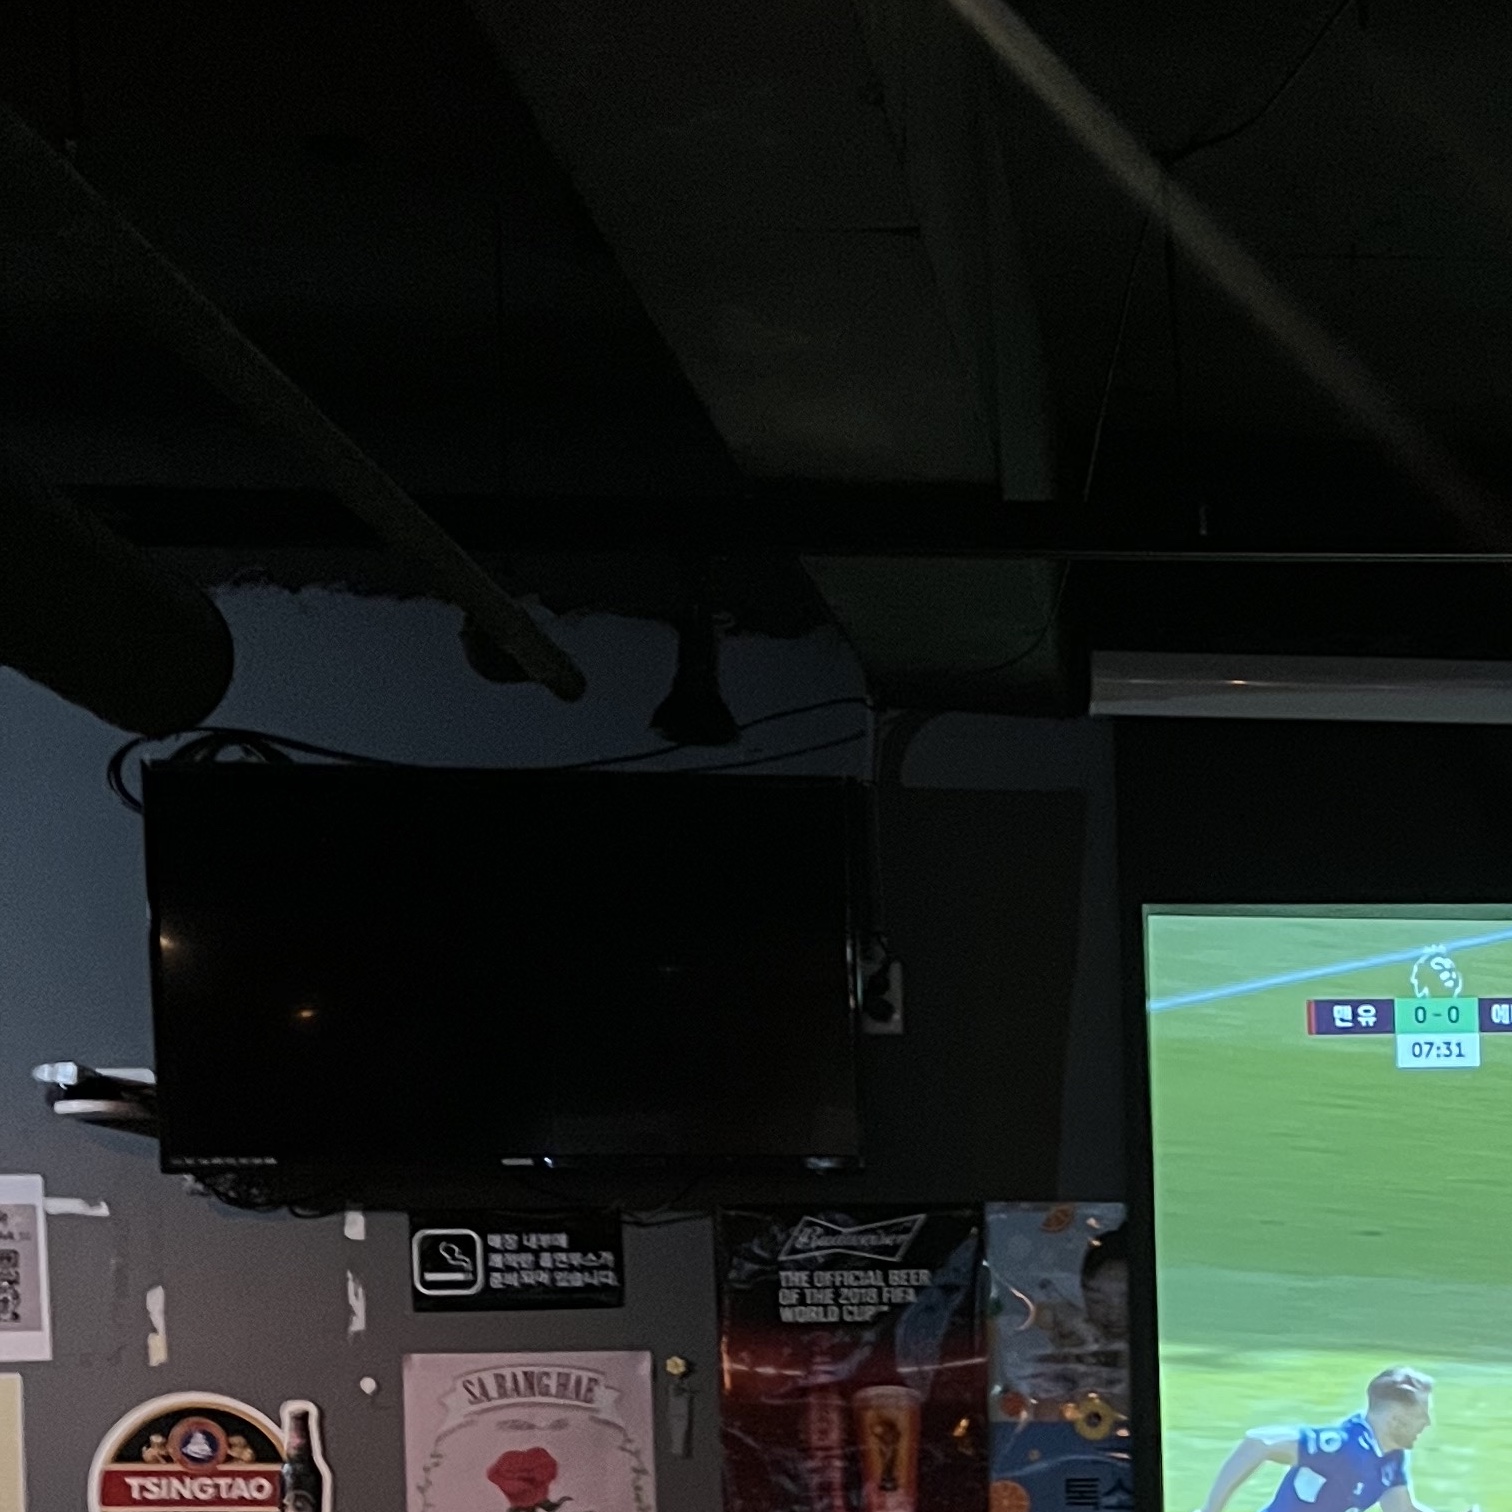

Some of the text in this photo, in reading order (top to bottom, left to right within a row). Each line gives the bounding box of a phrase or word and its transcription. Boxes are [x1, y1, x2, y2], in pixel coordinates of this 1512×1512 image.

[1411, 1041, 1466, 1059] 07:31
[778, 1268, 934, 1287] THE OFFICIAL BEER
[778, 1286, 918, 1305] OF THE 2018 FIFA
[779, 1305, 841, 1323] WORLD
[124, 1475, 274, 1501] TSINGTAO
